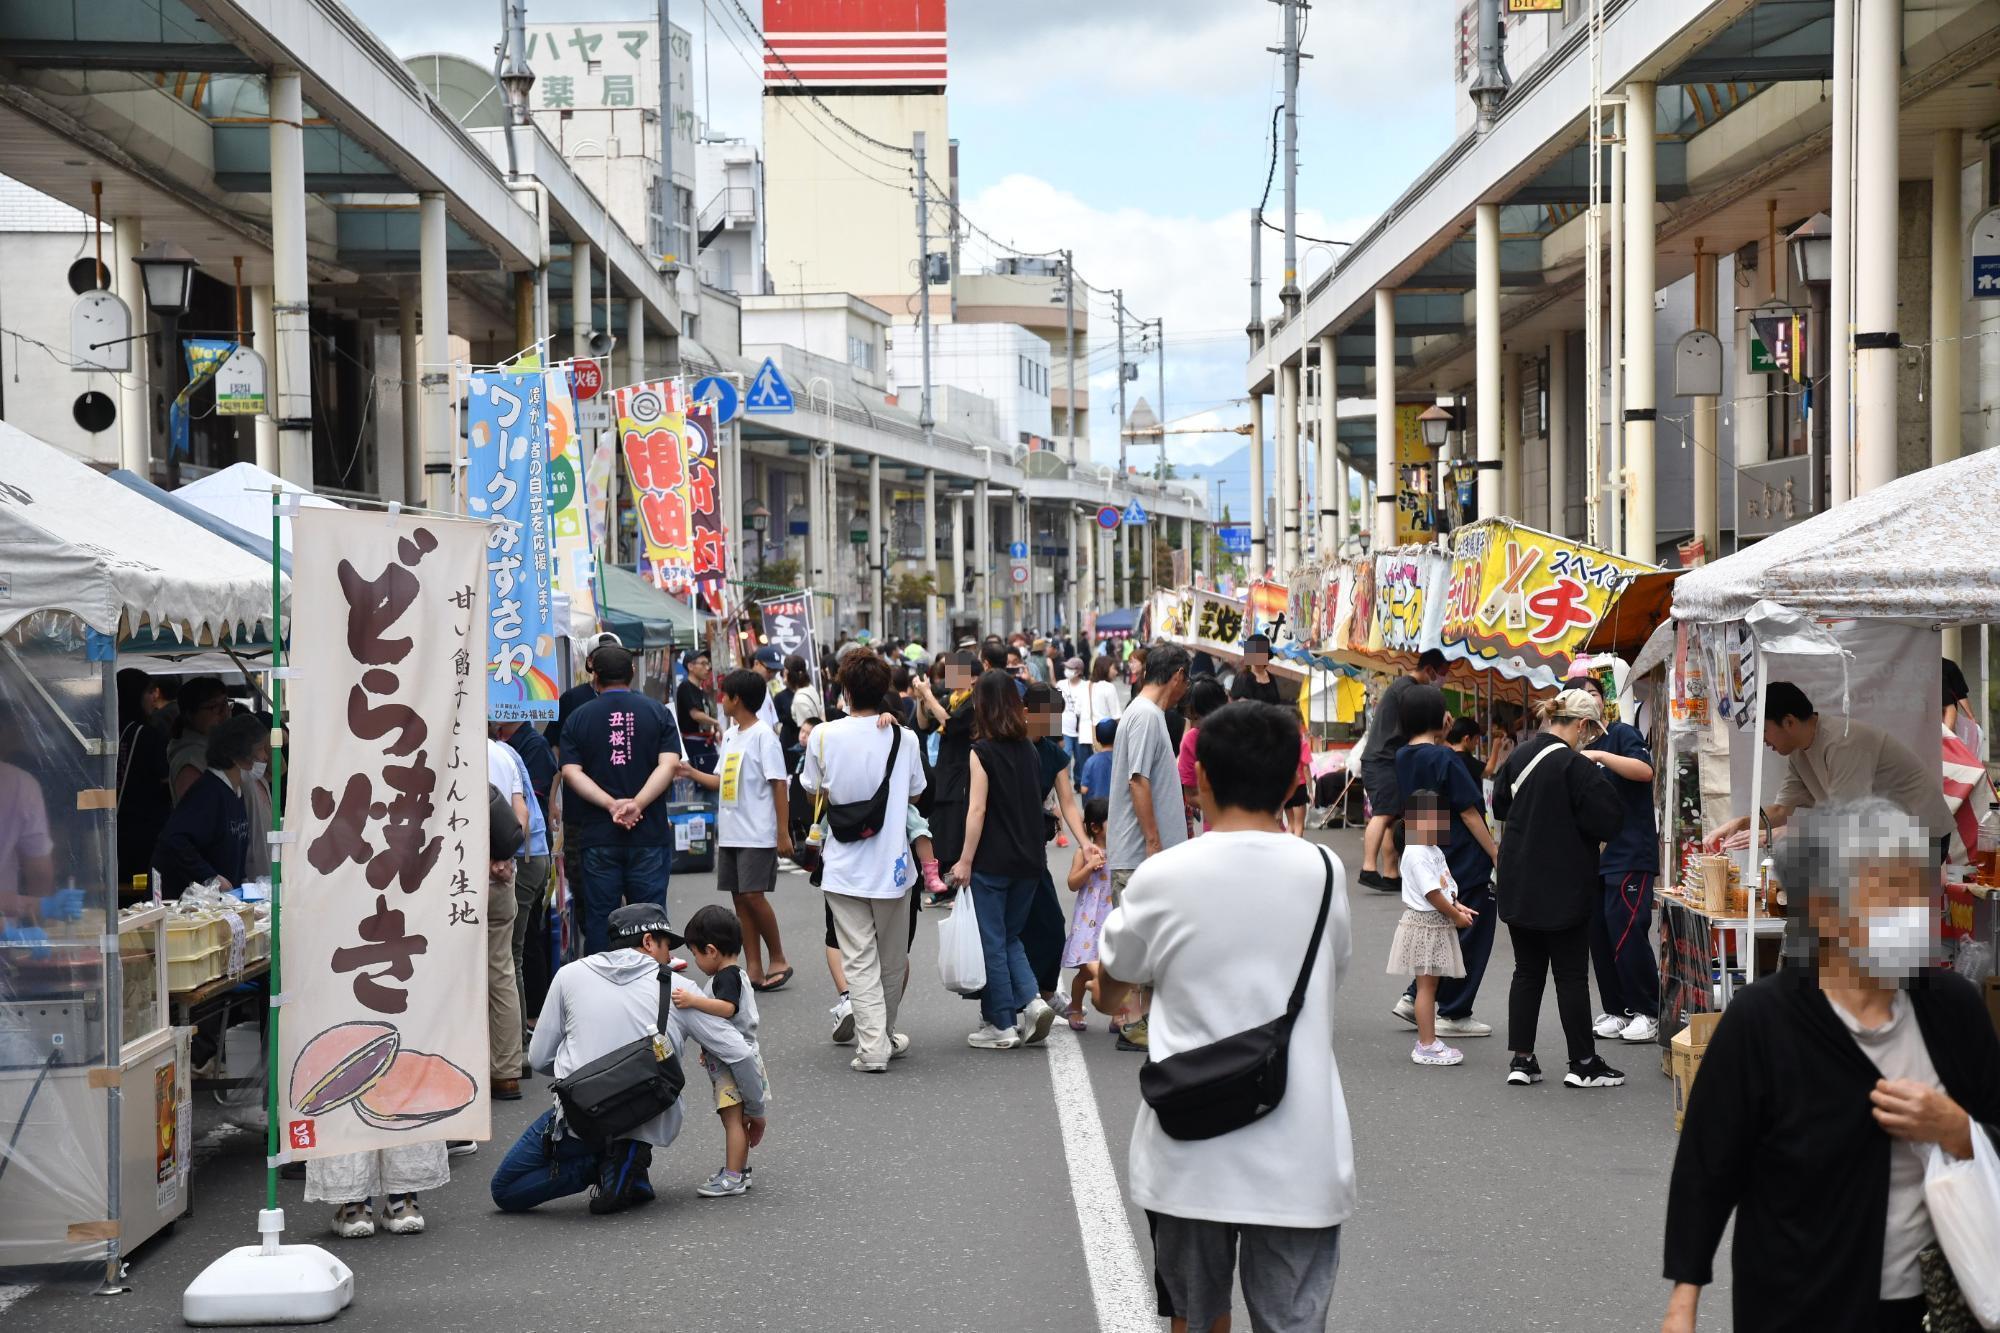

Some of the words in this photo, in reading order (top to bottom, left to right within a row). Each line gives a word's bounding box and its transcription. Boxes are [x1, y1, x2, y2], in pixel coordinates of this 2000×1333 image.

[526, 28, 649, 63] ハヤマ
[541, 75, 635, 108] 薬局
[487, 384, 534, 685] ワークみずさわ
[528, 386, 551, 625] 障がい者の自立を応援します
[307, 527, 446, 1015] どら焼き
[447, 584, 480, 928] 甘い餡子とふんわり生地
[494, 708, 555, 720] ひたかみ福祉会
[608, 711, 626, 766] 丑桜伝
